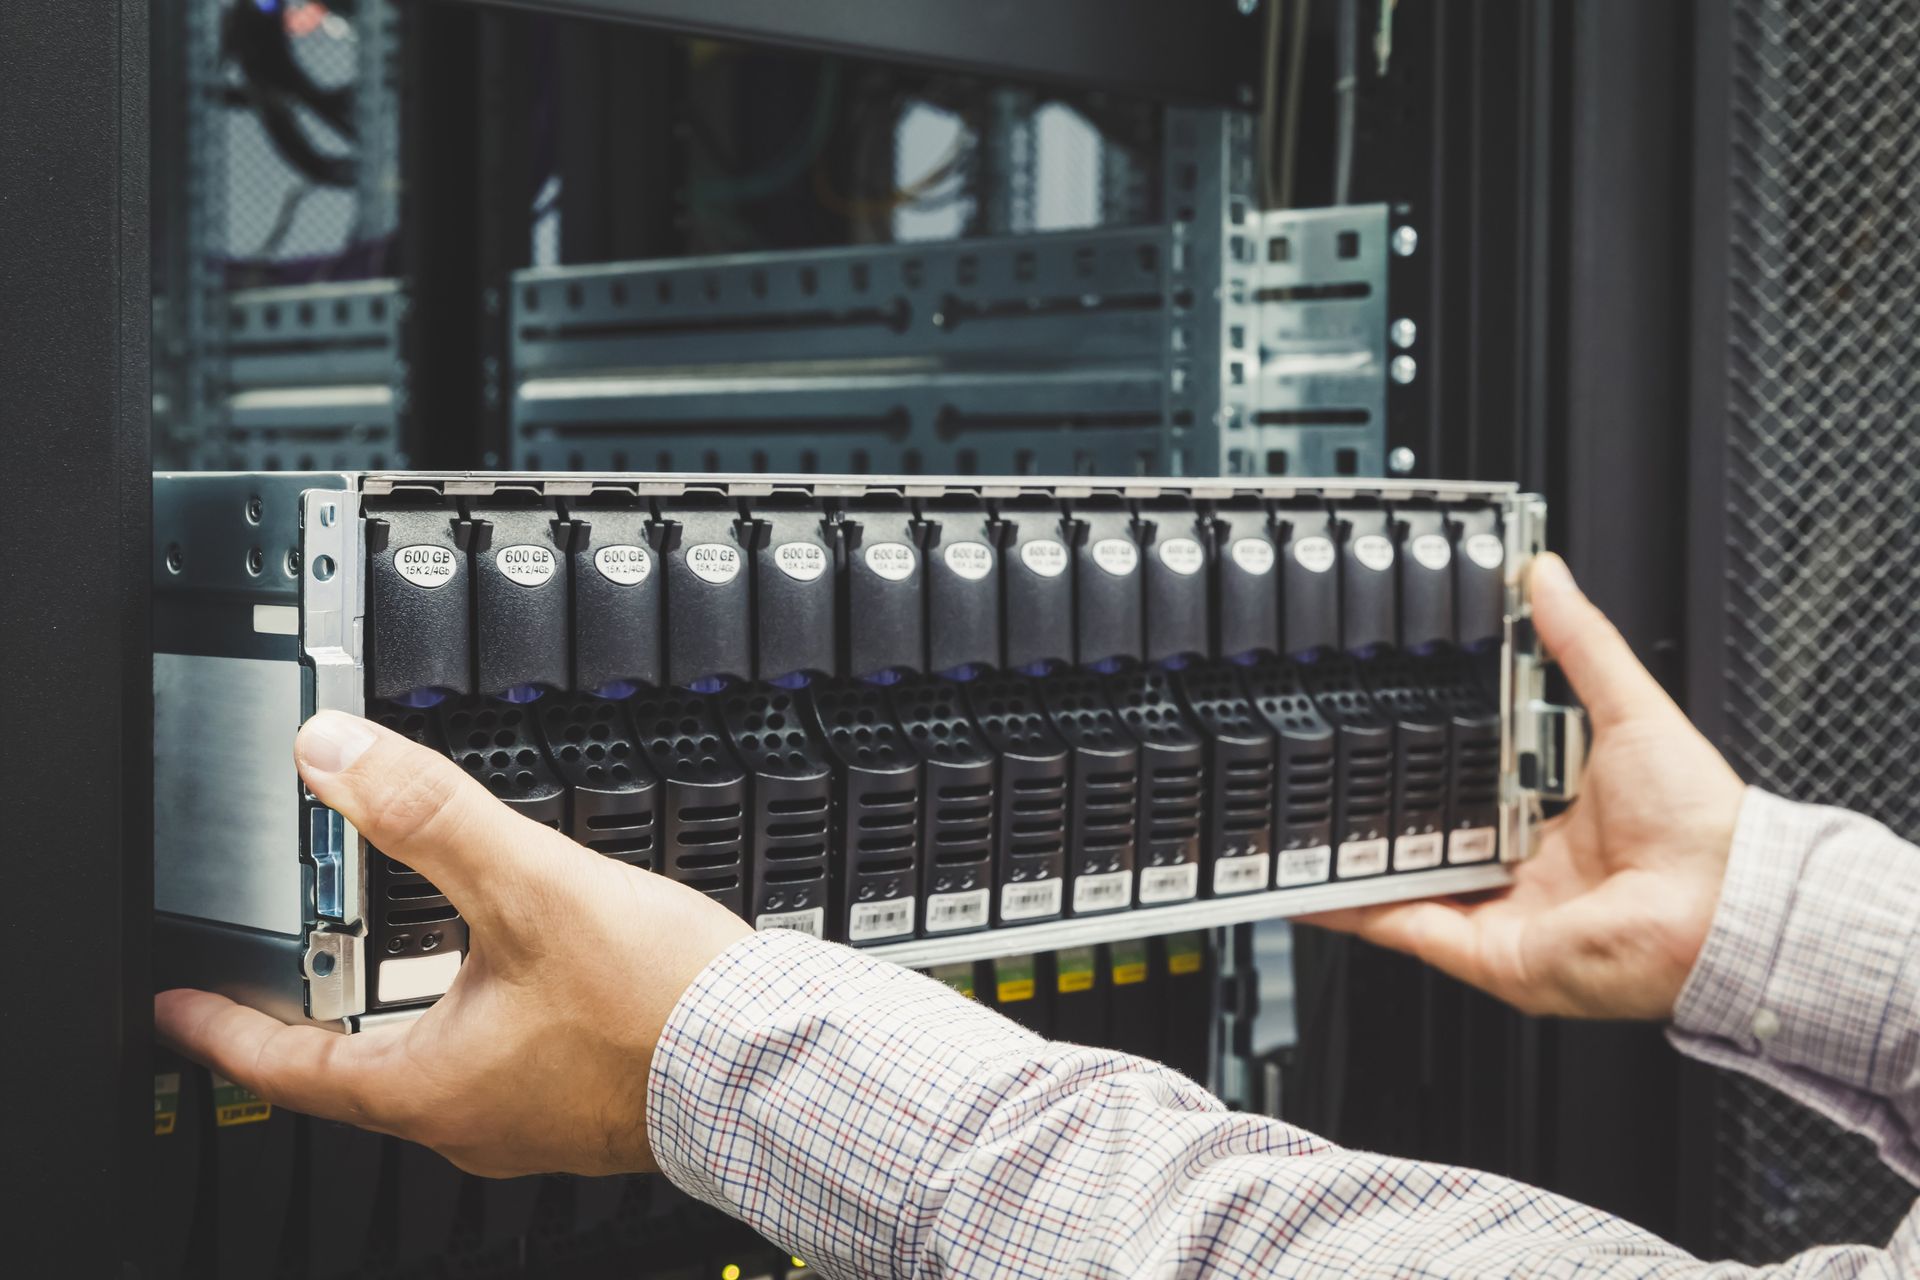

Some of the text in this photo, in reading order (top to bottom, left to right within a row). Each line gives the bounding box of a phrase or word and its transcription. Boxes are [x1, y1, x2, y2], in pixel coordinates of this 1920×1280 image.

[404, 550, 450, 563] 600 GB
[505, 550, 549, 563] 600 GB
[603, 550, 645, 563] 600 GB
[695, 549, 735, 562] 600 GB
[782, 548, 820, 560] 600 GB
[405, 566, 450, 576] 15K 2/4Gb
[507, 565, 549, 575] 15K 2/4Gb
